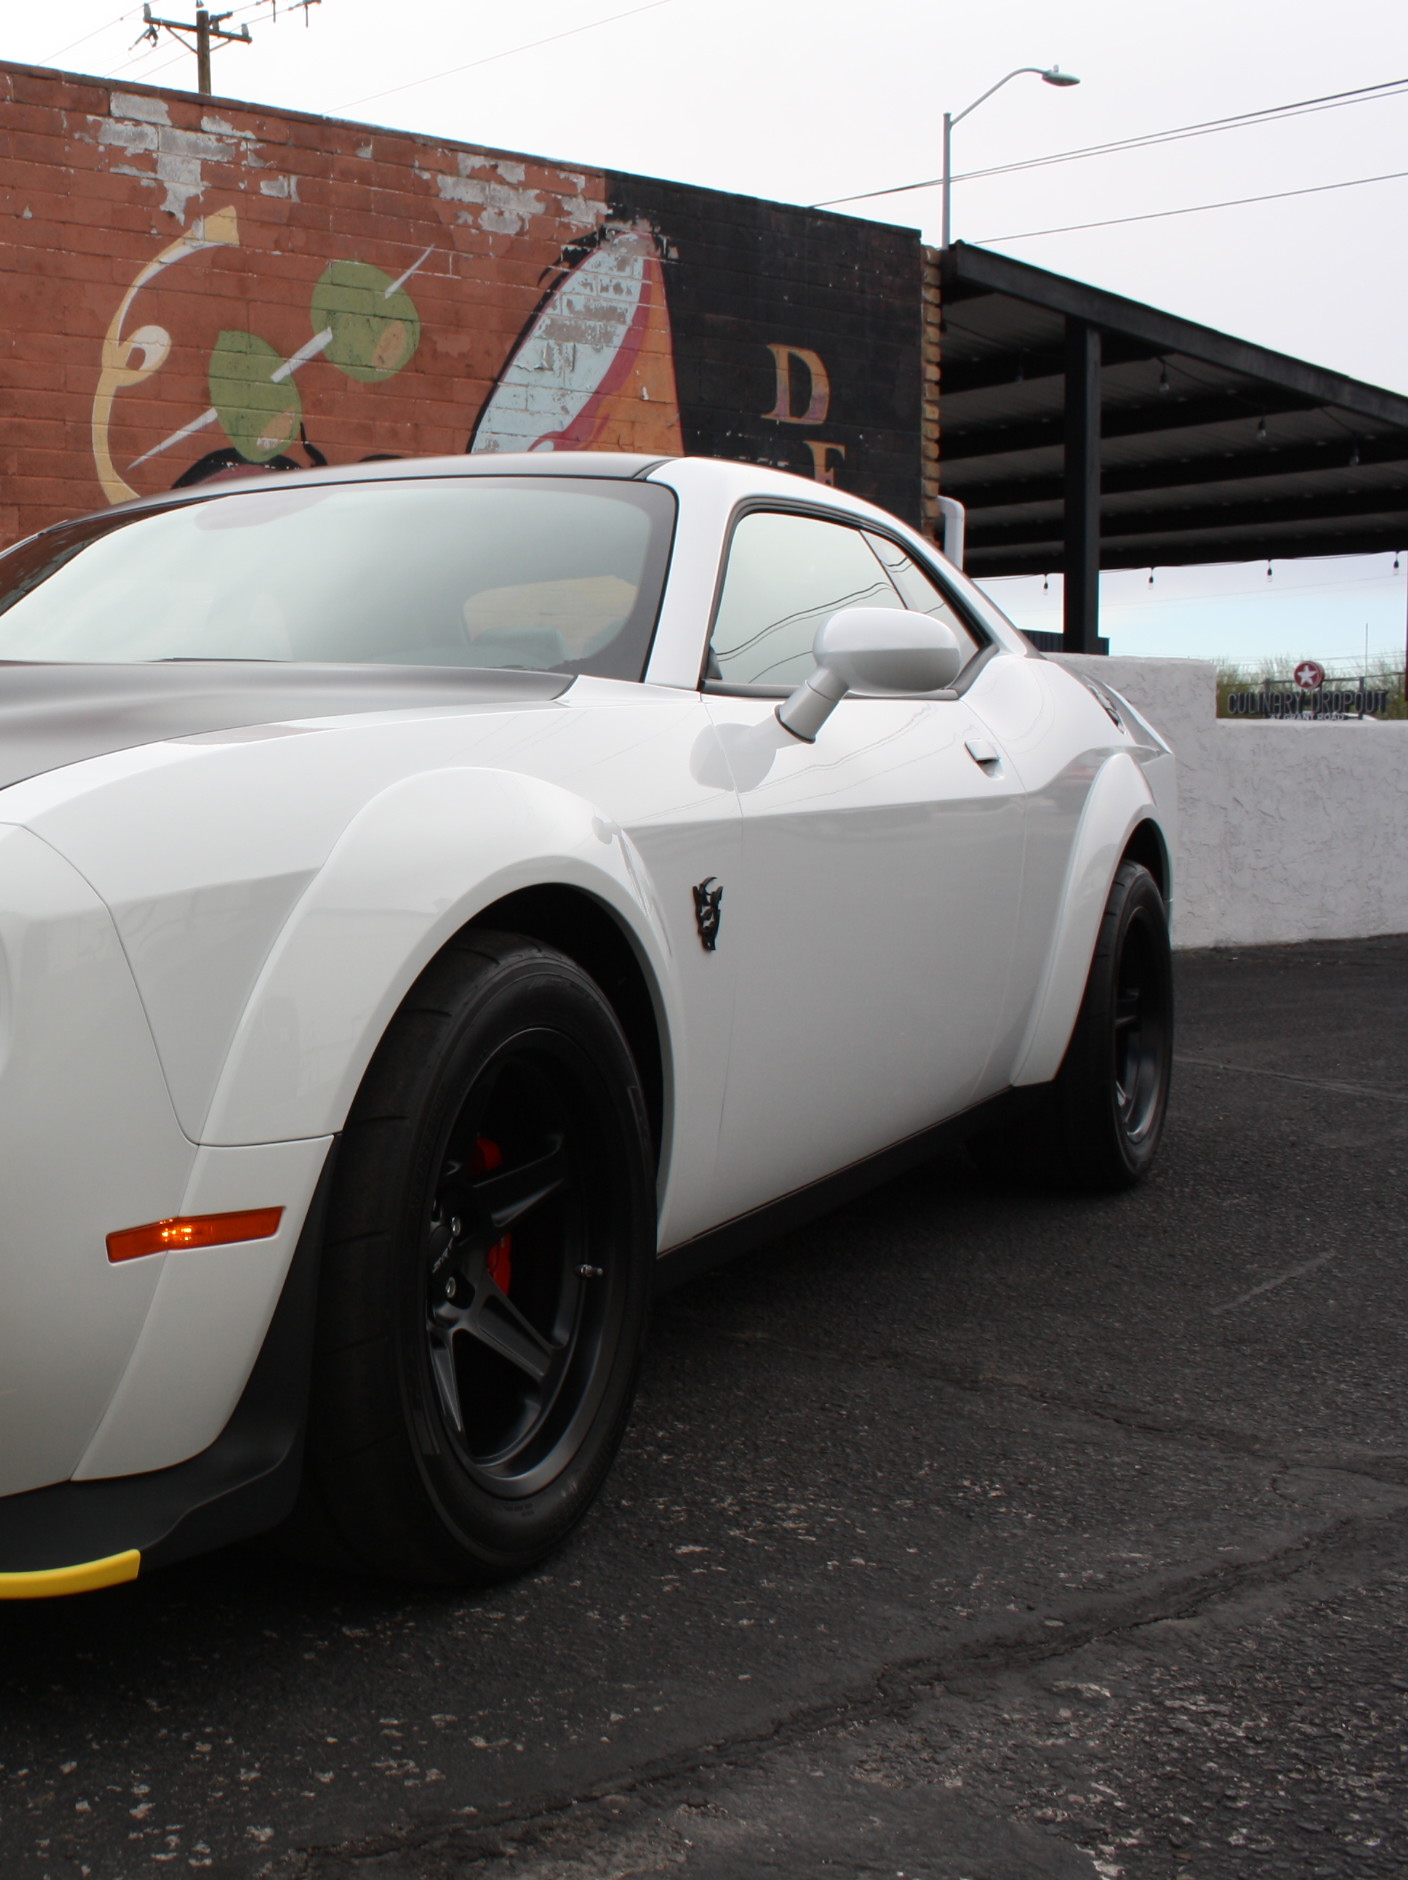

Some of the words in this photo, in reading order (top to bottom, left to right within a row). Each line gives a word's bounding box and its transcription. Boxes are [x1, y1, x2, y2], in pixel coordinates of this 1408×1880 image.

[760, 343, 830, 425] D
[1226, 691, 1303, 715] CULINARY
[1310, 689, 1387, 715] DROPOUT
[1316, 712, 1345, 720] ROAD
